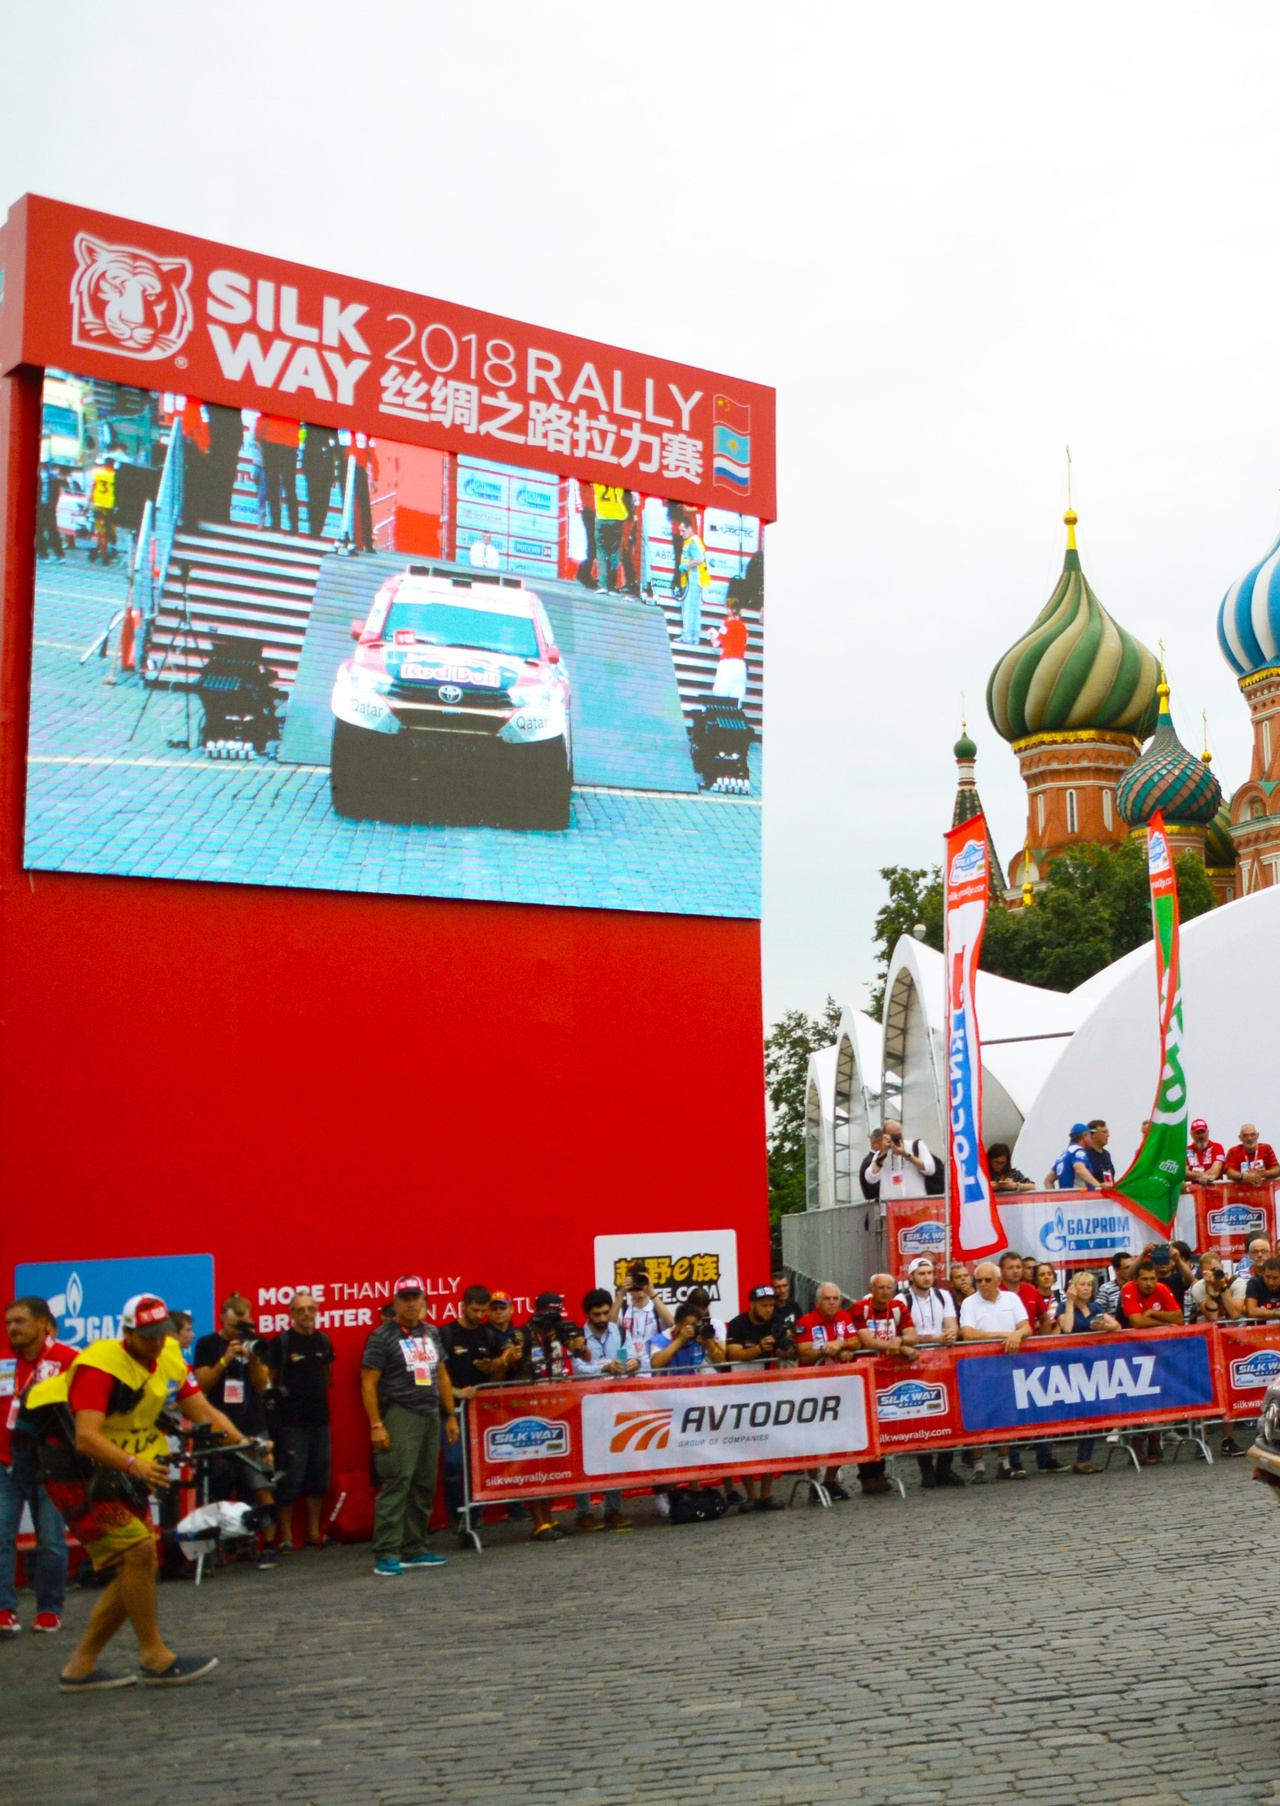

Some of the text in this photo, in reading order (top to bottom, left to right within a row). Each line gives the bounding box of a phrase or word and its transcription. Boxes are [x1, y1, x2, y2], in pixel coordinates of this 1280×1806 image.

[207, 270, 371, 355] SILK
[207, 323, 371, 405] WAY
[384, 314, 703, 431] 2018 RALLY
[379, 365, 704, 485] 丝绸之路拉力赛
[404, 664, 499, 686] Red Bull
[352, 699, 384, 718] Qatar
[516, 716, 548, 730] Qatar
[1067, 1216, 1130, 1236] GAZPROM
[1214, 1213, 1260, 1223] SILK WAY
[905, 1232, 930, 1240] SILK
[1069, 1237, 1130, 1251] AVIA
[330, 1281, 390, 1301] THAN
[258, 1308, 373, 1333] BRHTER
[1238, 1363, 1266, 1374] SILK
[1012, 1355, 1161, 1410] KAMAZ
[880, 1390, 938, 1405] SILK WAY
[680, 1395, 842, 1434] AVTODOR
[494, 1429, 560, 1444] SILK WAY
[678, 1434, 769, 1448] GROUP OF COMPANIES
[880, 1428, 952, 1443] ilkwayrally.com
[485, 1471, 572, 1487] silkwayrally.com
